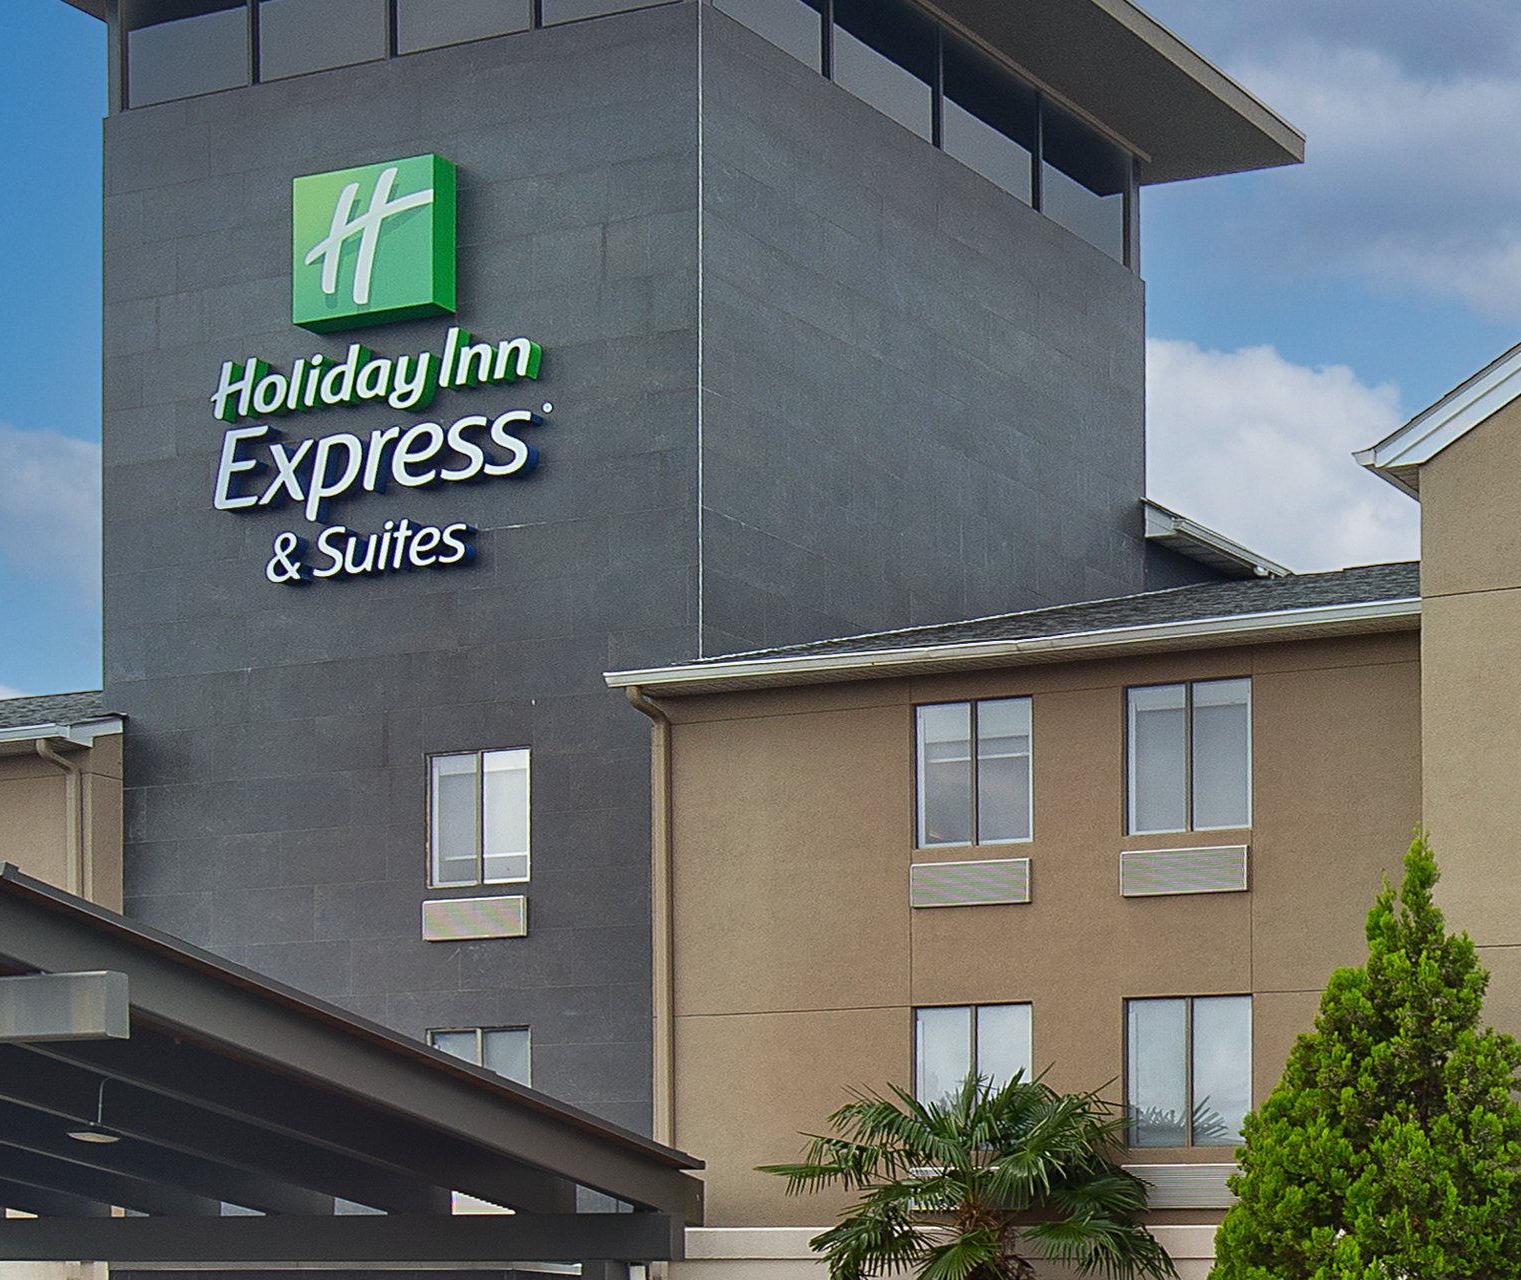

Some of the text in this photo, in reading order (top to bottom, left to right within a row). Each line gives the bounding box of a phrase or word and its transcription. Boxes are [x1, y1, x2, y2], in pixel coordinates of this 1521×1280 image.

[304, 166, 434, 305] H
[210, 326, 532, 421] Holiday Inn
[212, 409, 533, 522] Express
[265, 518, 468, 584] & Suites
